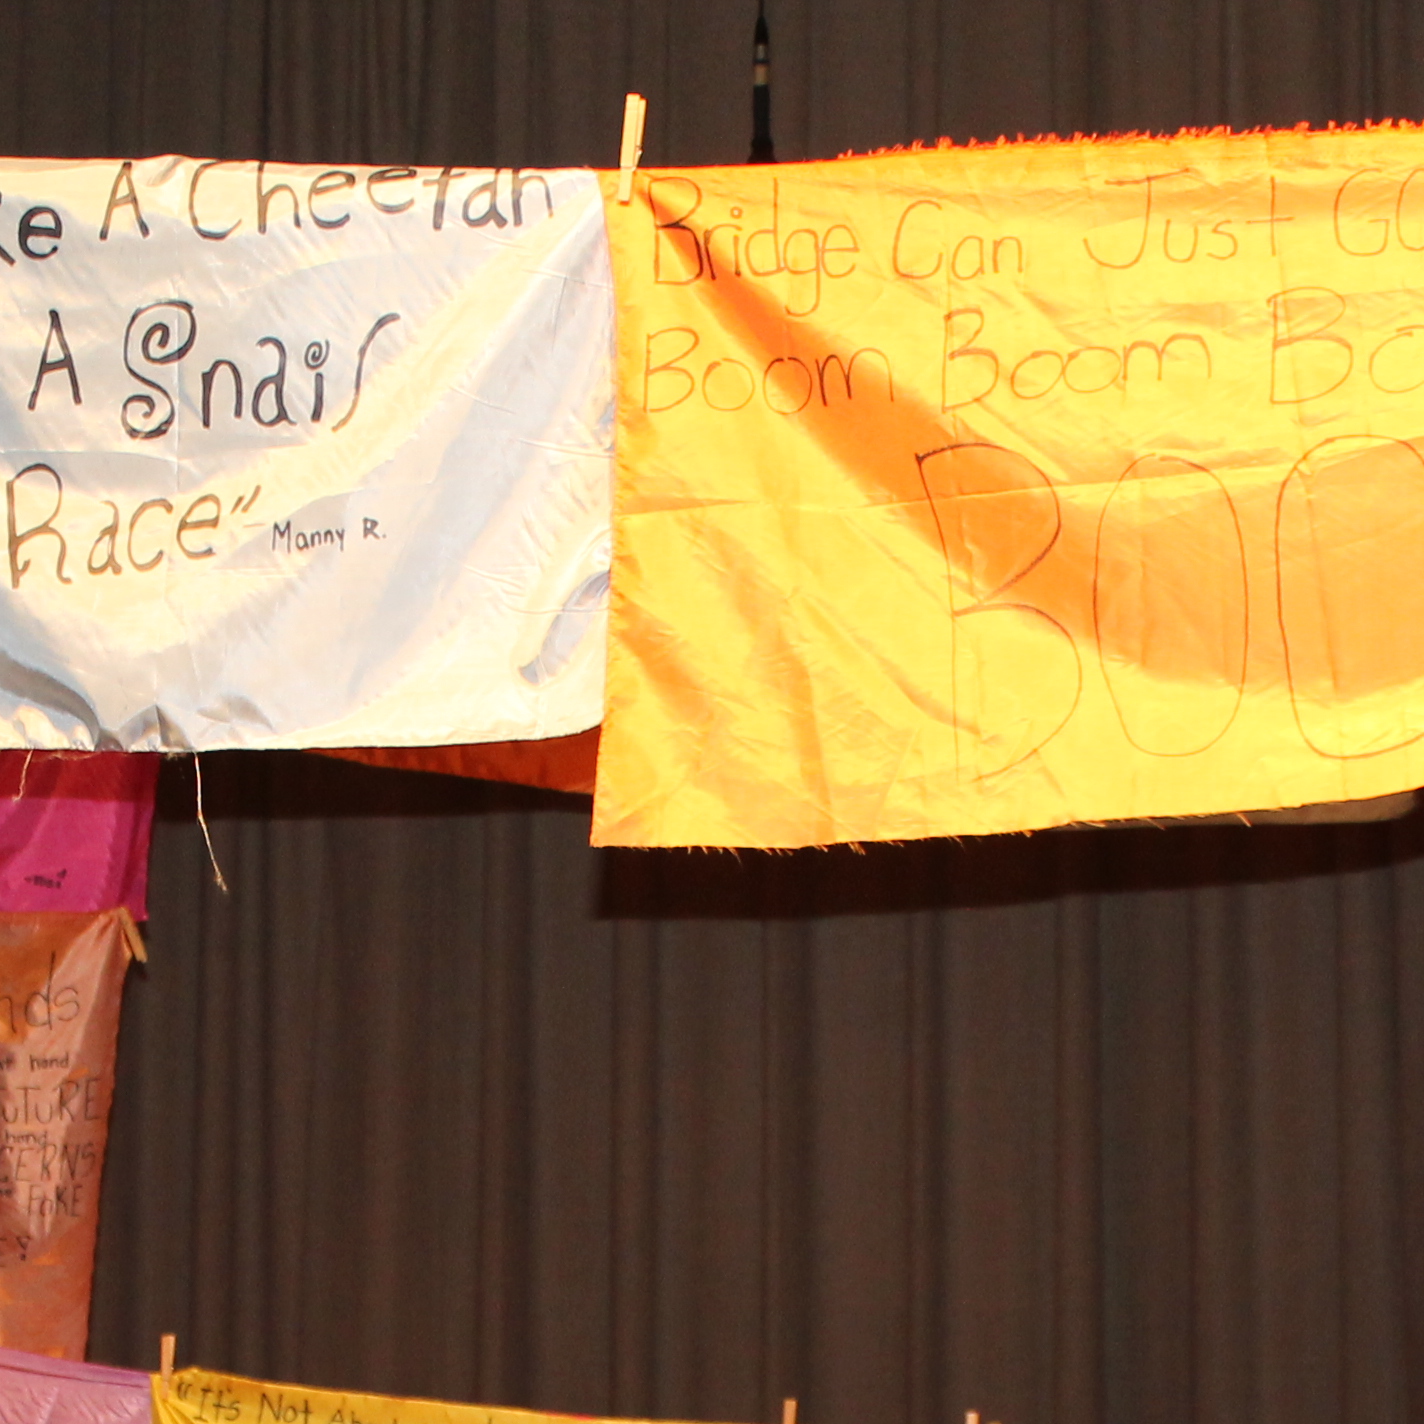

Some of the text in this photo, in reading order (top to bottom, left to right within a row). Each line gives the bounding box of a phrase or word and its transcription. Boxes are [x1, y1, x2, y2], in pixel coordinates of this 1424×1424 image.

[99, 160, 151, 241] A
[645, 175, 860, 318] Bridge
[892, 199, 1024, 282] Can
[1084, 168, 1294, 269] Just
[28, 309, 84, 411] A
[642, 328, 895, 415] Boom
[941, 308, 1213, 413] Boom
